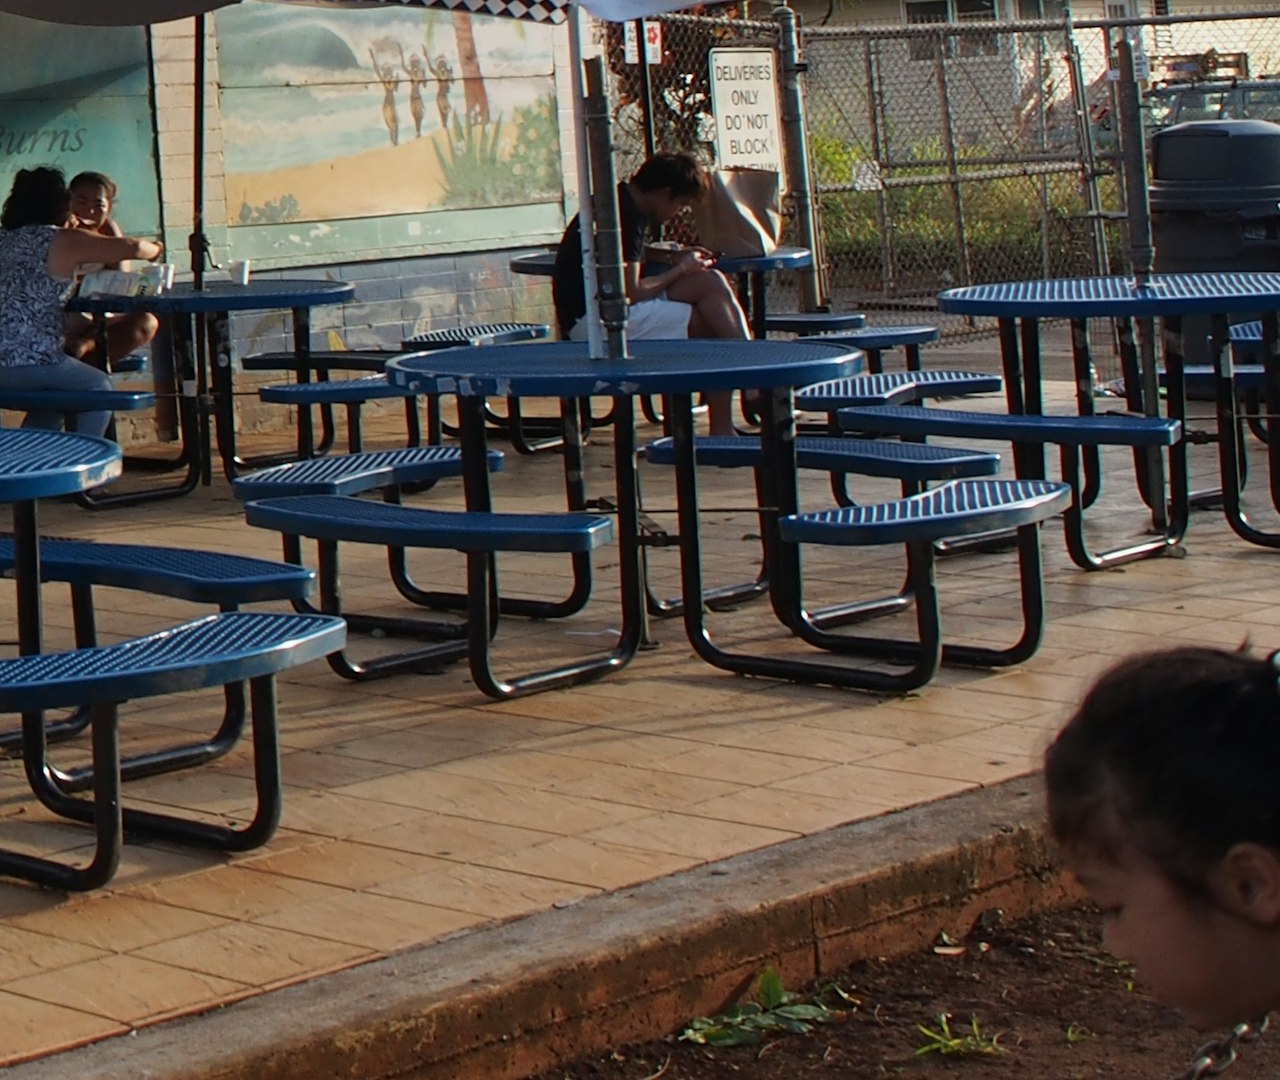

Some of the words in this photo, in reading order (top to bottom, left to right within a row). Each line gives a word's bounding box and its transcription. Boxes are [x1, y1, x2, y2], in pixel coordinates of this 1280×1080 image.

[716, 65, 771, 81] DELIVERIES
[731, 90, 759, 106] ONLY
[725, 114, 742, 130] DO
[746, 114, 768, 130] NOT
[730, 138, 770, 155] BLOCK
